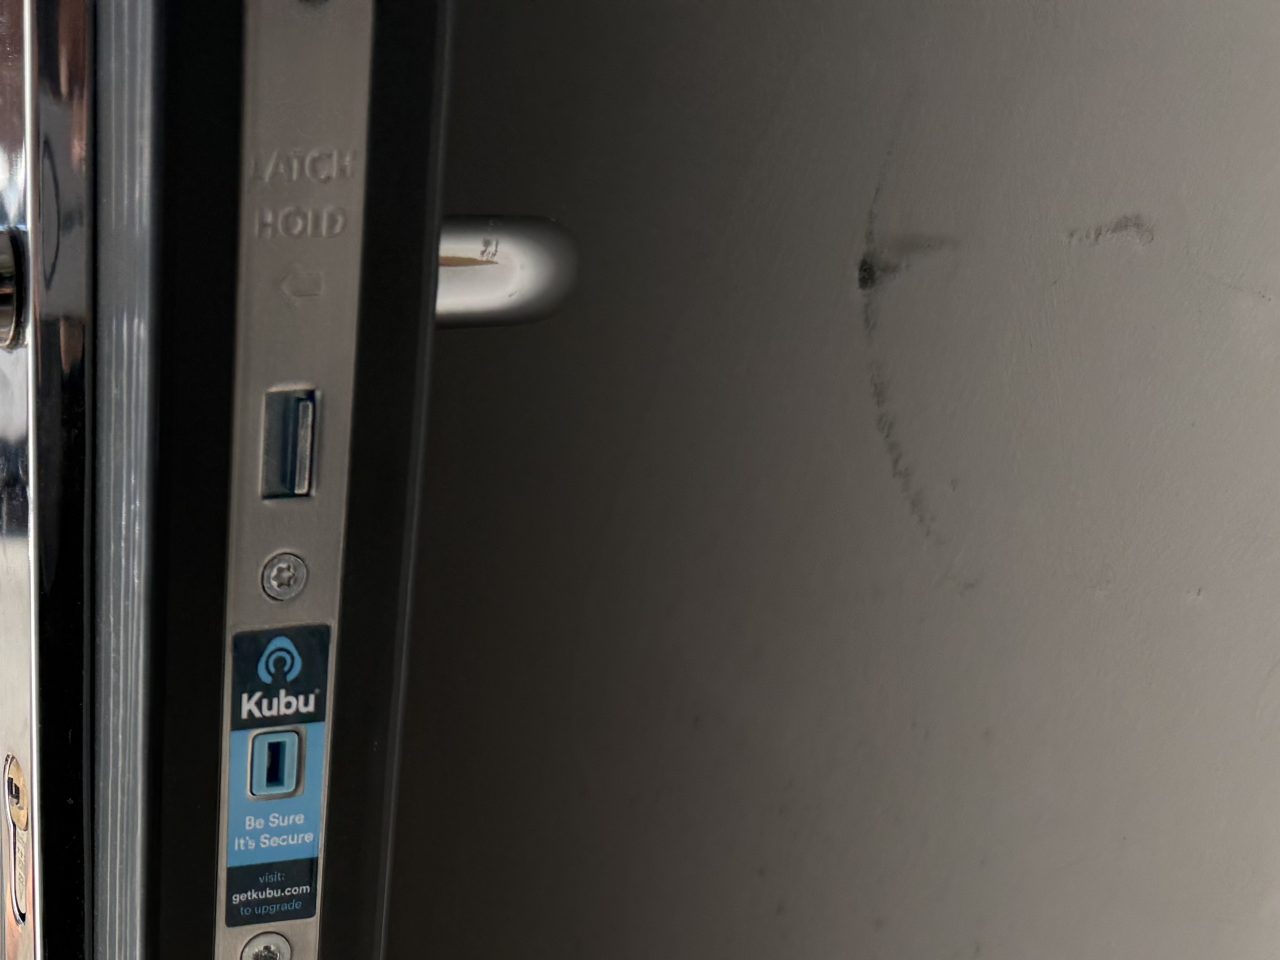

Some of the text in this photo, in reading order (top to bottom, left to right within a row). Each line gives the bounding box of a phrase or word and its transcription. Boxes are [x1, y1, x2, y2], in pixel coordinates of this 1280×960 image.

[254, 205, 347, 239] HOLD
[241, 688, 315, 720] Kubu
[245, 812, 305, 831] Be Sure
[234, 831, 314, 851] It's Secure
[258, 871, 286, 884] visit:
[231, 884, 311, 905] getkubu.com
[240, 899, 303, 916] to upgrade
